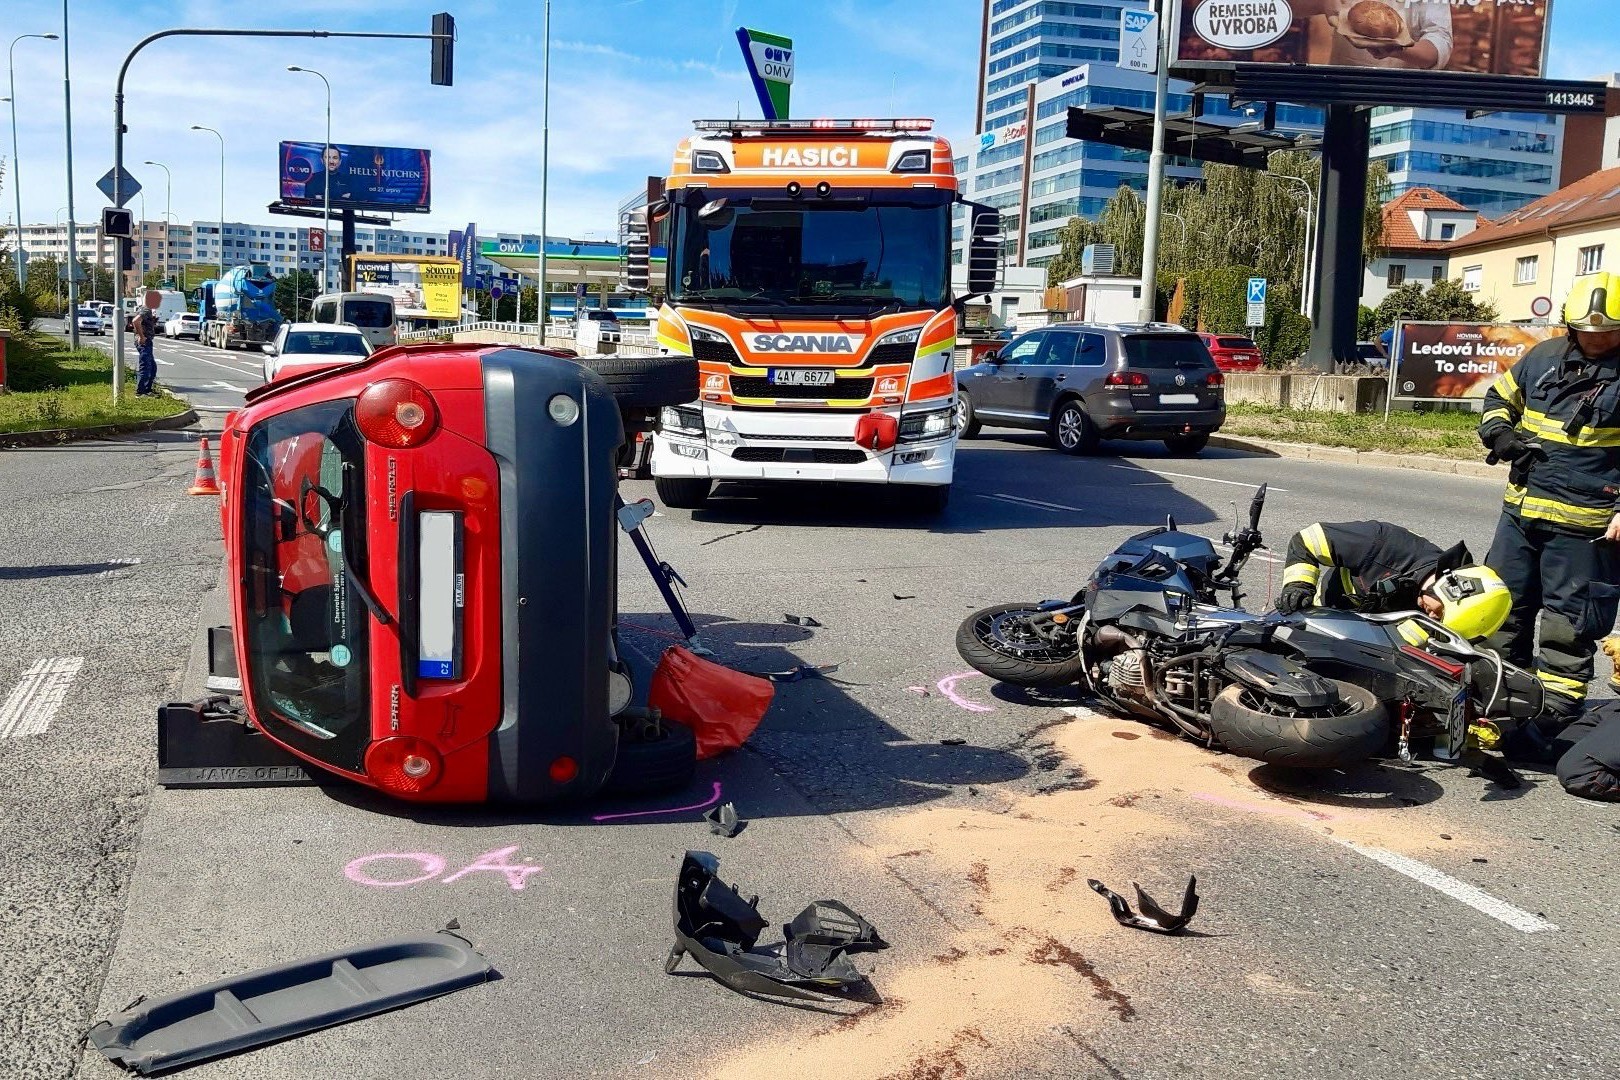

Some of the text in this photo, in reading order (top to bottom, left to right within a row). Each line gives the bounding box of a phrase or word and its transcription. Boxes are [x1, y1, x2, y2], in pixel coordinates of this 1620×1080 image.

[1210, 0, 1277, 18] ŘEMESLNÁ
[1126, 14, 1148, 30] SAP
[1209, 15, 1278, 36] VÝROBA
[764, 64, 790, 78] OMV
[1548, 92, 1594, 106] 1413445
[762, 144, 858, 167] HASIČI
[349, 166, 420, 178] HELL'S KITCHEN
[500, 243, 524, 253] OMV
[363, 271, 376, 282] 1/2
[426, 266, 456, 274] SCONTO
[753, 334, 853, 352] SCANIA
[1412, 342, 1526, 356] Ledová káva?
[941, 352, 950, 372] 7
[1435, 360, 1498, 374] To chci!
[777, 372, 830, 382] 4AY 6677
[441, 663, 449, 675] CZ
[391, 684, 400, 730] SPARK
[196, 768, 249, 780] JAWS
[255, 768, 280, 780] OF
